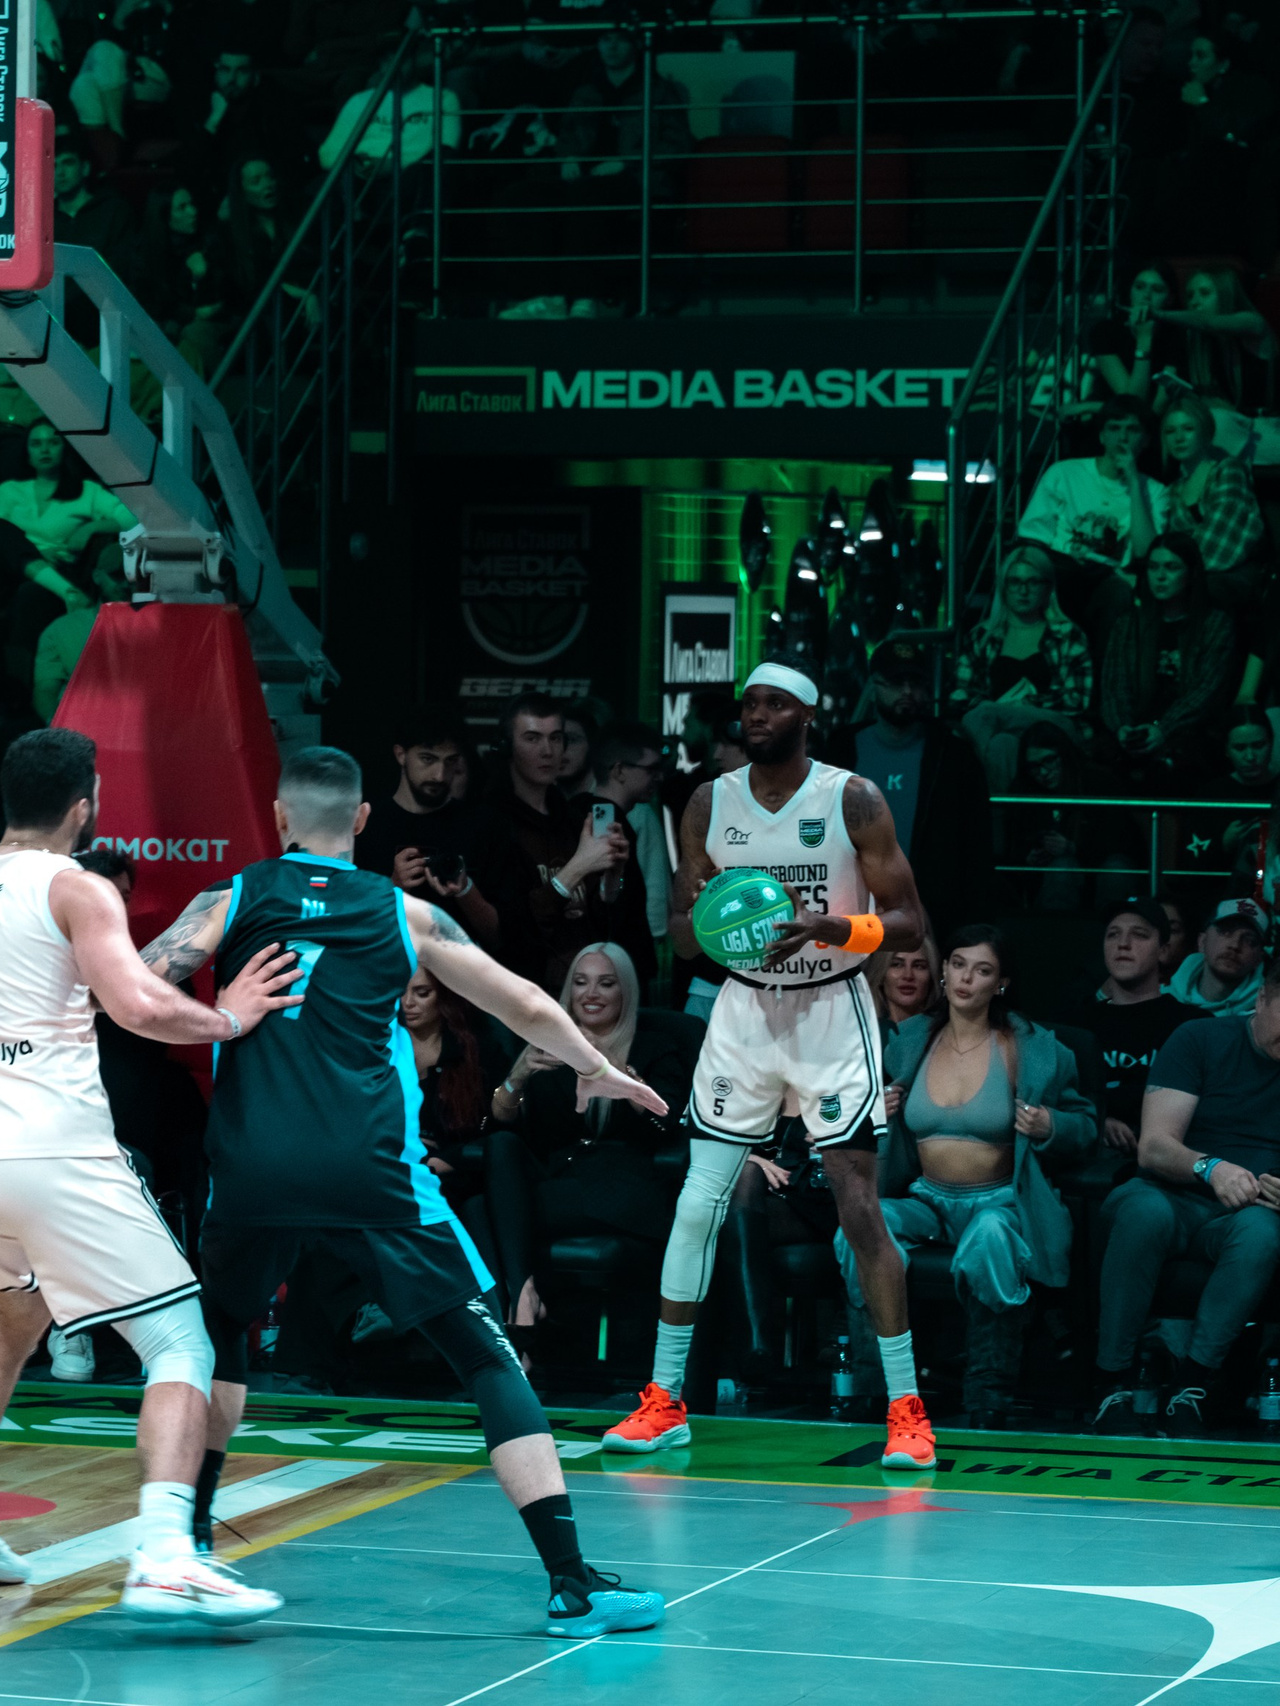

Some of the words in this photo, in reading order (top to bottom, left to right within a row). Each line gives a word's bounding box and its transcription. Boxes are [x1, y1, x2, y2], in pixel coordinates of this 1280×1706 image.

[542, 369, 727, 409] MEDIA
[733, 368, 970, 408] BASKET
[460, 554, 589, 577] MEDIA
[460, 580, 589, 597] BASKET
[91, 836, 229, 861] амокат
[721, 927, 753, 952] LIGA
[713, 1098, 725, 1117] 5
